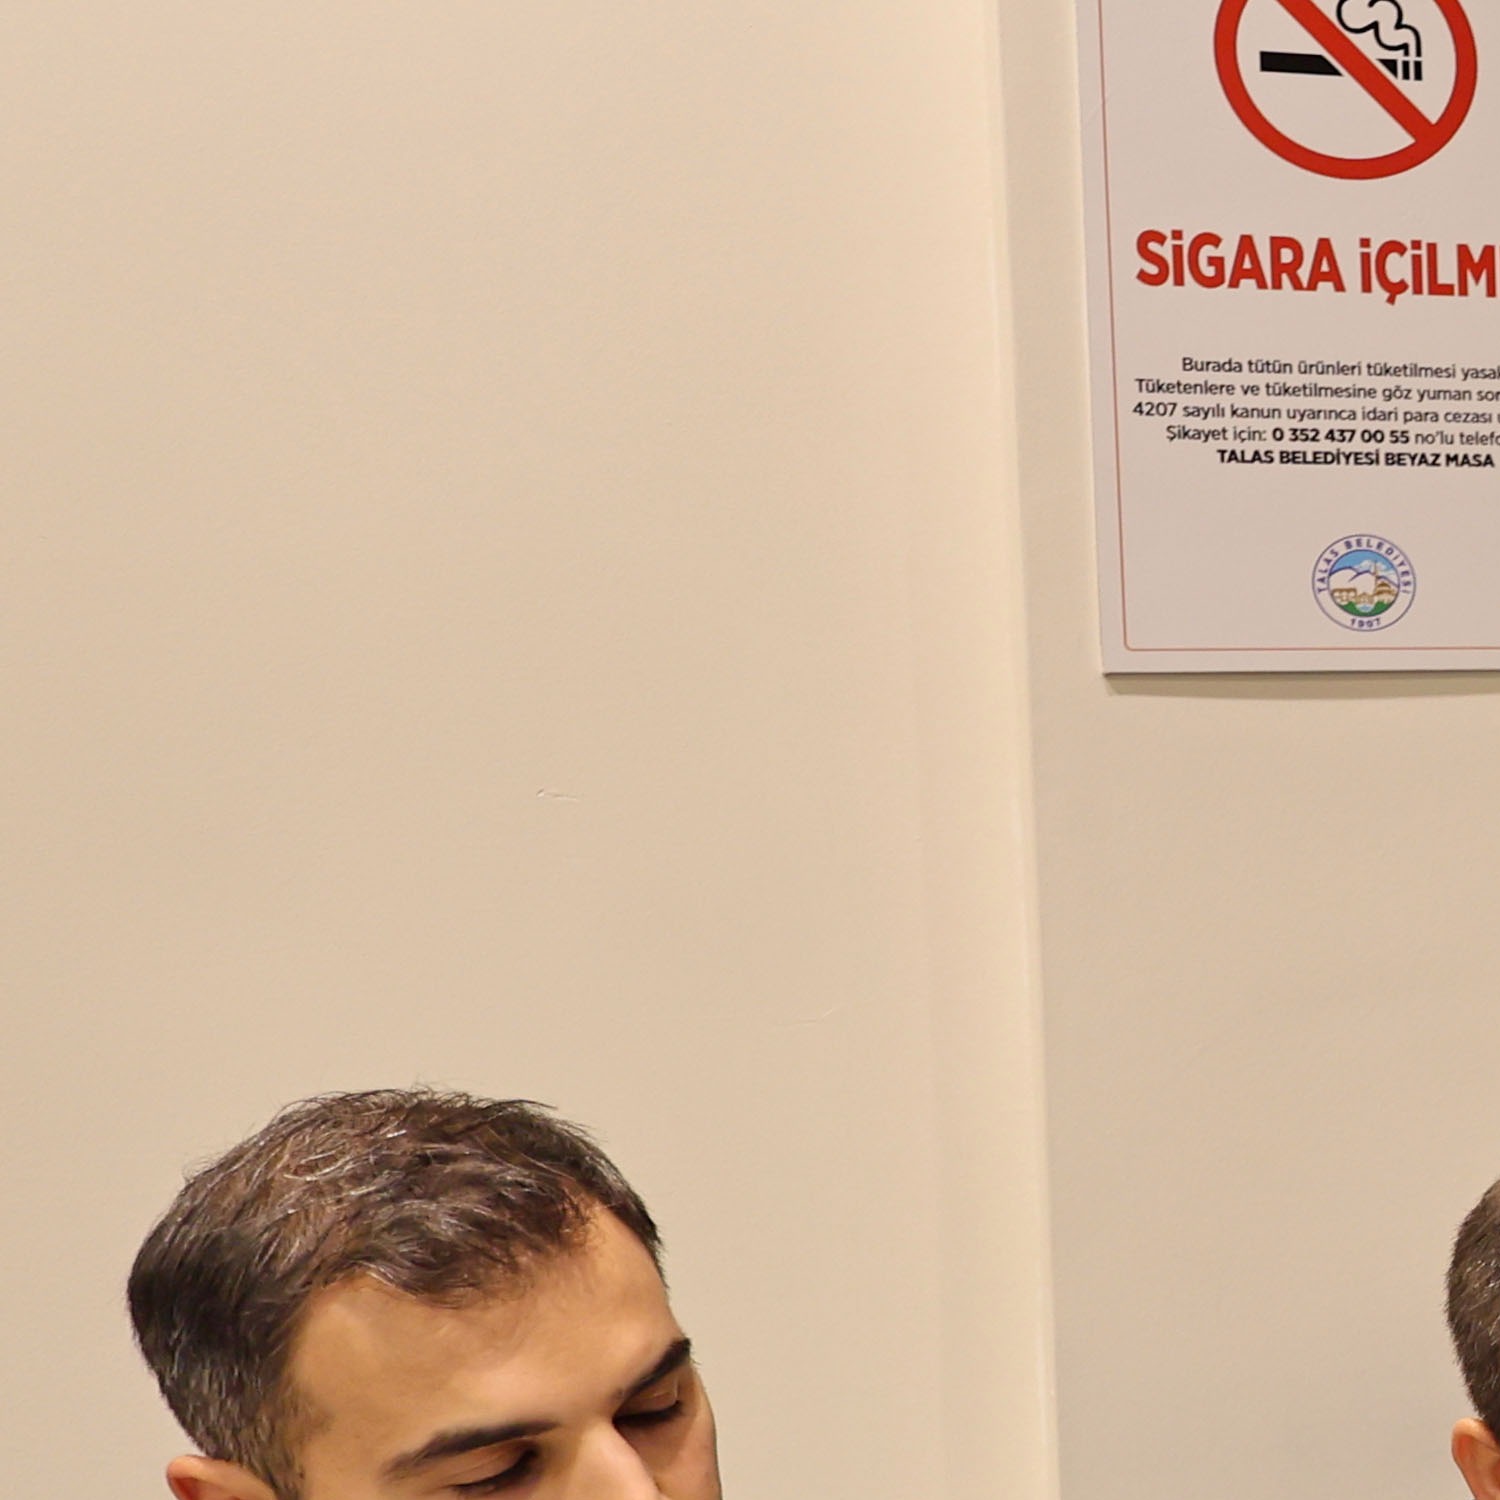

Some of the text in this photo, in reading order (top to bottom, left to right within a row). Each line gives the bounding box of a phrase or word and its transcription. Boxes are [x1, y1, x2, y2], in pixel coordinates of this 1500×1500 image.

[1181, 357, 1243, 373] Burada
[1248, 359, 1293, 375] tütün
[1298, 360, 1362, 377] ürünleri
[1366, 362, 1456, 379] tüketilmesi
[1135, 378, 1235, 396] Tüketenlere
[1241, 384, 1260, 396] ve
[1265, 382, 1377, 399] tüketilmesine
[1382, 385, 1412, 402] göz
[1417, 389, 1472, 403] yuman
[1132, 401, 1177, 417] 4207
[1182, 403, 1225, 421] sayılı
[1230, 403, 1282, 419] kanun
[1286, 406, 1357, 423] uyarınca
[1361, 406, 1398, 422] idari
[1403, 410, 1439, 425] para
[1443, 411, 1492, 424] cezası
[1166, 424, 1228, 443] Şikayet
[1233, 426, 1266, 444] için:
[1272, 427, 1284, 441] 0
[1288, 428, 1320, 442] 352
[1324, 428, 1356, 443] 437
[1360, 429, 1385, 443] 00
[1389, 430, 1410, 444] 55
[1216, 448, 1496, 468] TALAS BELEDİYESİ BEYAZ MASA
[1316, 548, 1339, 592] TALAS
